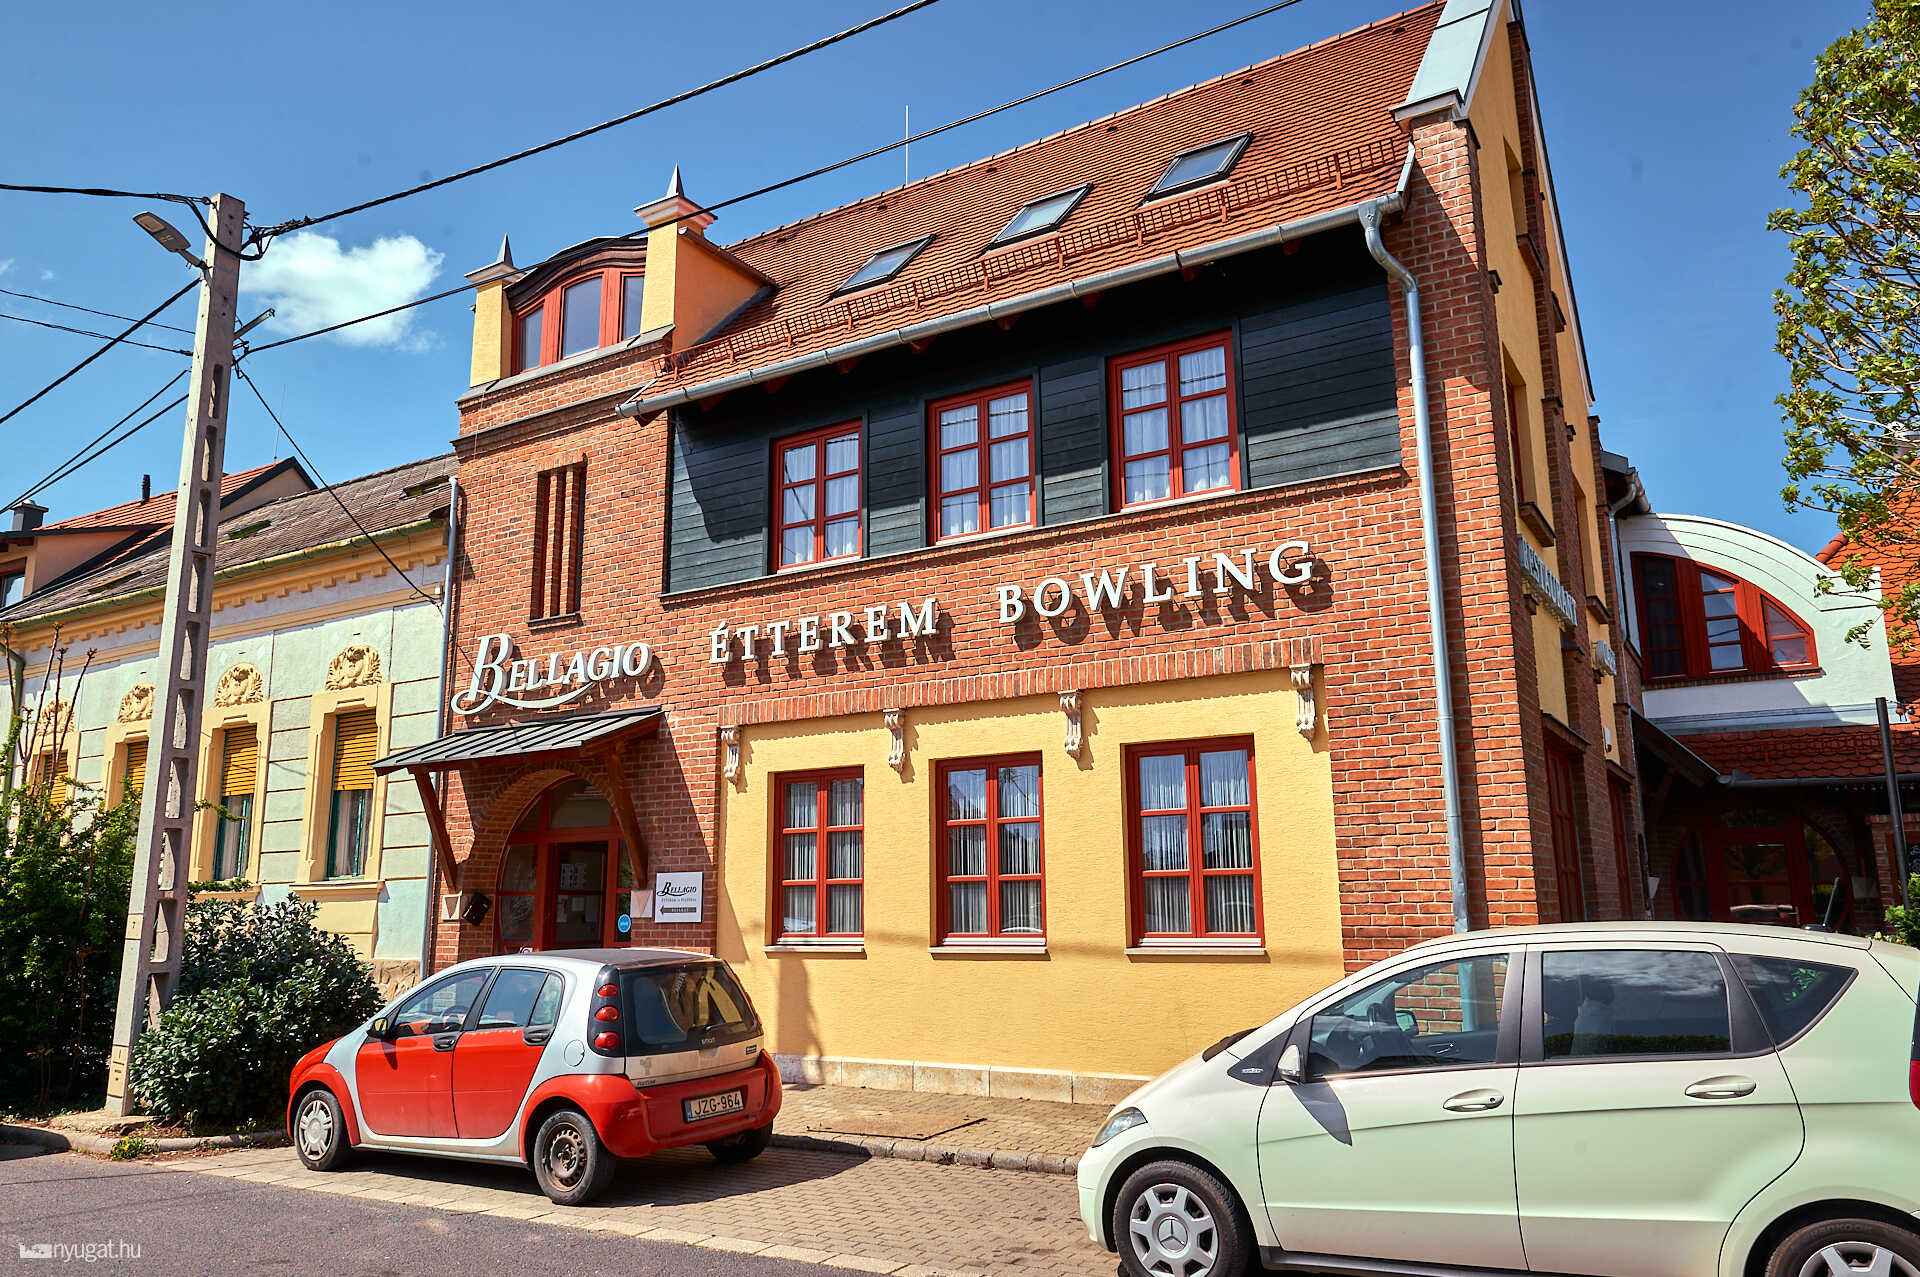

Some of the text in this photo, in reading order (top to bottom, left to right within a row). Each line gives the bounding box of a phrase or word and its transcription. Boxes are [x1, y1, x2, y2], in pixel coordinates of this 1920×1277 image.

[709, 540, 1313, 664] ÉTTEREM BOWLING
[694, 1093, 741, 1115] JZG-964
